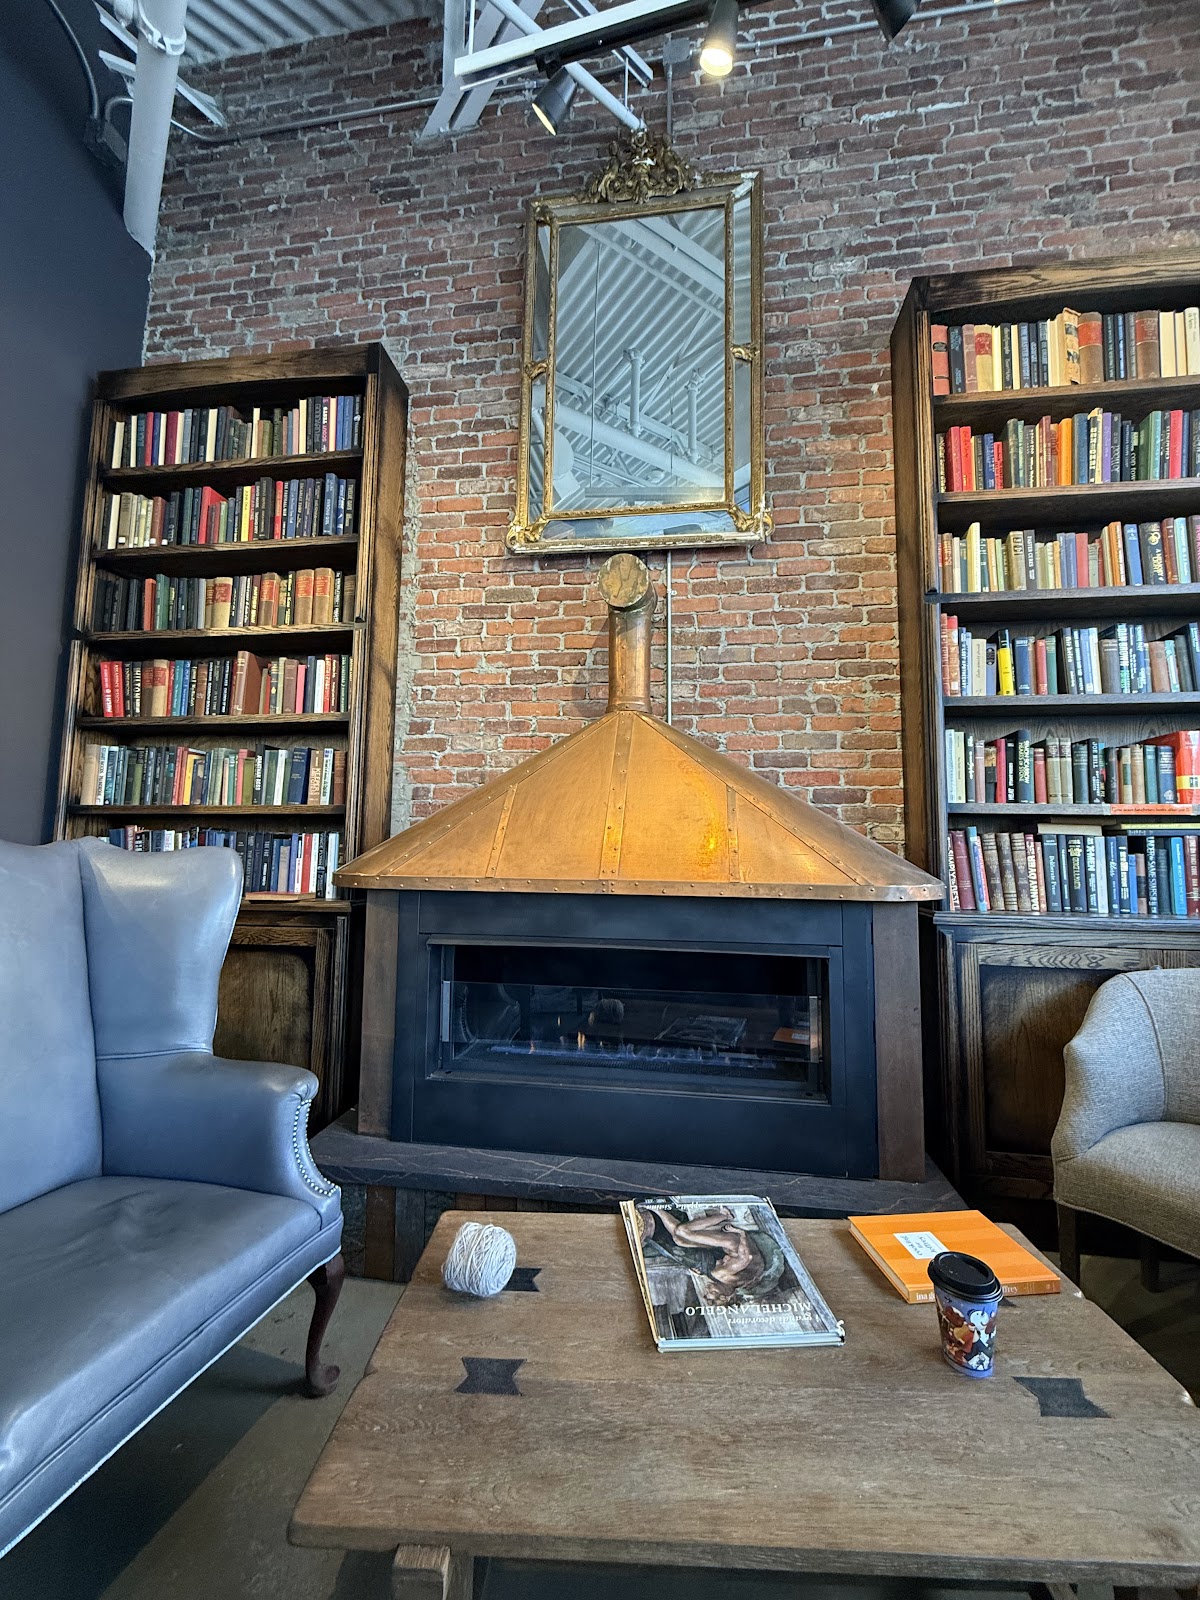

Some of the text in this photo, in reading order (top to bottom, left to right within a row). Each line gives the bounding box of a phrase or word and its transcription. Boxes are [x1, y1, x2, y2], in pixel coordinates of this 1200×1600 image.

[1118, 628, 1129, 666] DAN BROWN
[1146, 836, 1155, 856] UNDER
[948, 850, 957, 879] SIMPLY
[1148, 861, 1156, 877] SAME
[1028, 855, 1039, 910] DANNY DYER
[951, 885, 959, 903] BEST
[916, 1293, 928, 1301] ina
[684, 1301, 811, 1316] MICHELANGELO
[727, 1316, 775, 1326] decoratori
[778, 1312, 812, 1324] grandi
